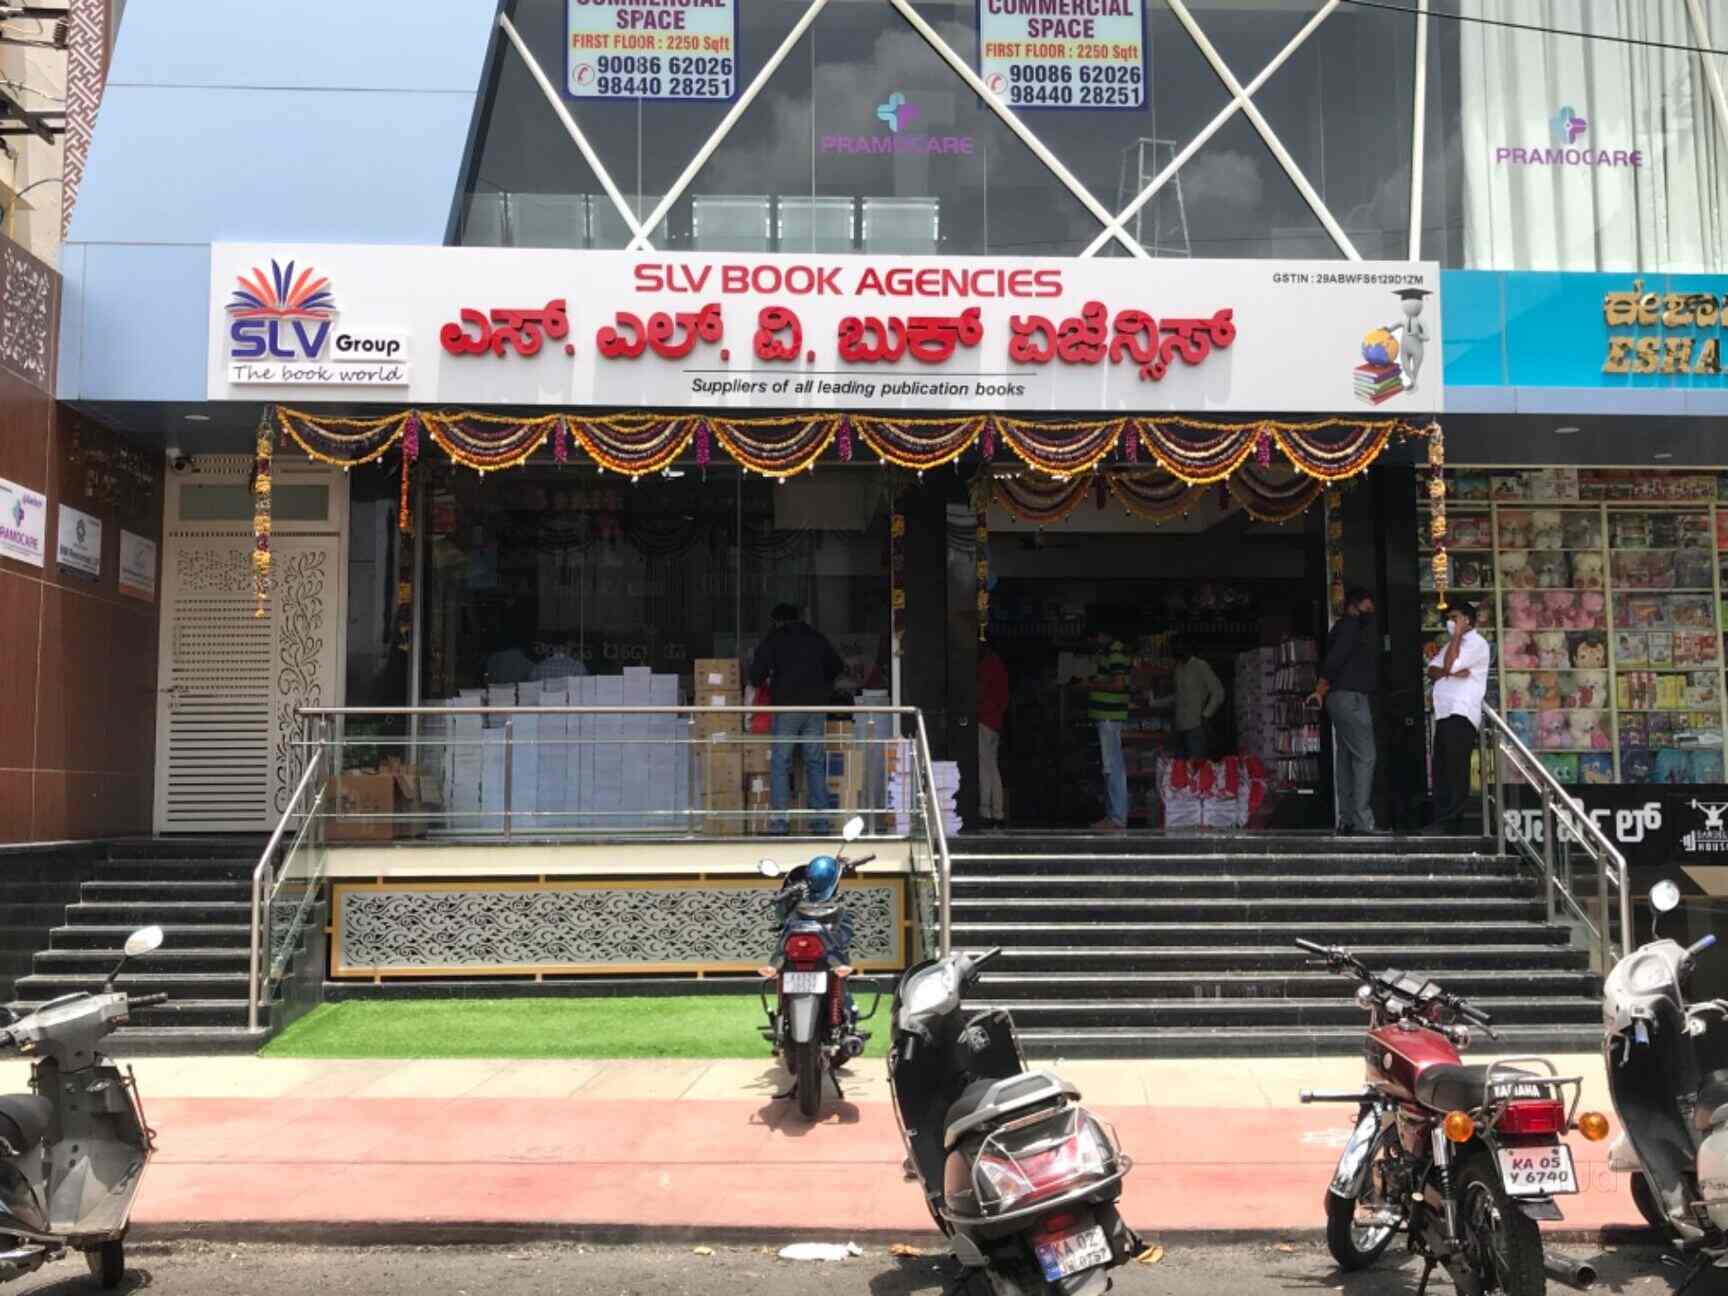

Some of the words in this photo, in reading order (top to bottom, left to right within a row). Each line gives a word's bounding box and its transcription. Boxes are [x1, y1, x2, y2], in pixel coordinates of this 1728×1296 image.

[616, 9, 686, 30] SPACE
[1028, 18, 1095, 38] SPACE
[572, 34, 610, 49] FIRST
[614, 35, 655, 49] FLOOR
[667, 36, 700, 50] 2250
[703, 37, 729, 53] Sqft
[985, 43, 1021, 57] FIRST
[1024, 44, 1065, 58] FLOOR
[1077, 44, 1108, 59] 2250
[1112, 45, 1138, 61] Sqft
[597, 56, 661, 74] 90086
[669, 57, 733, 75] 62026
[1010, 65, 1072, 83] 90086
[1079, 66, 1141, 84] 62026
[597, 77, 662, 95] 98440
[669, 78, 731, 96] 28251
[1010, 86, 1072, 103] 98440
[1080, 87, 1140, 104] 28251
[1496, 148, 1643, 167] PRAMOCARE
[633, 263, 713, 293] SLV
[721, 264, 843, 296] BOOK
[855, 267, 1063, 298] AGENCIES
[1273, 273, 1309, 284] GSTIN
[231, 320, 332, 358] SLV
[336, 334, 400, 357] Group
[837, 306, 984, 363] ಬುಕ್
[1602, 337, 1728, 373] ESHA
[233, 366, 273, 380] The
[282, 365, 333, 380] book
[340, 365, 402, 381] world
[692, 378, 767, 395] Suppliers
[773, 379, 790, 393] of
[794, 379, 813, 394] all
[818, 380, 876, 398] leading
[881, 382, 969, 399] publication
[975, 383, 1025, 396] books
[1512, 1158, 1534, 1171] KA
[1540, 1157, 1561, 1169] 05
[1525, 1171, 1568, 1184] 6740
